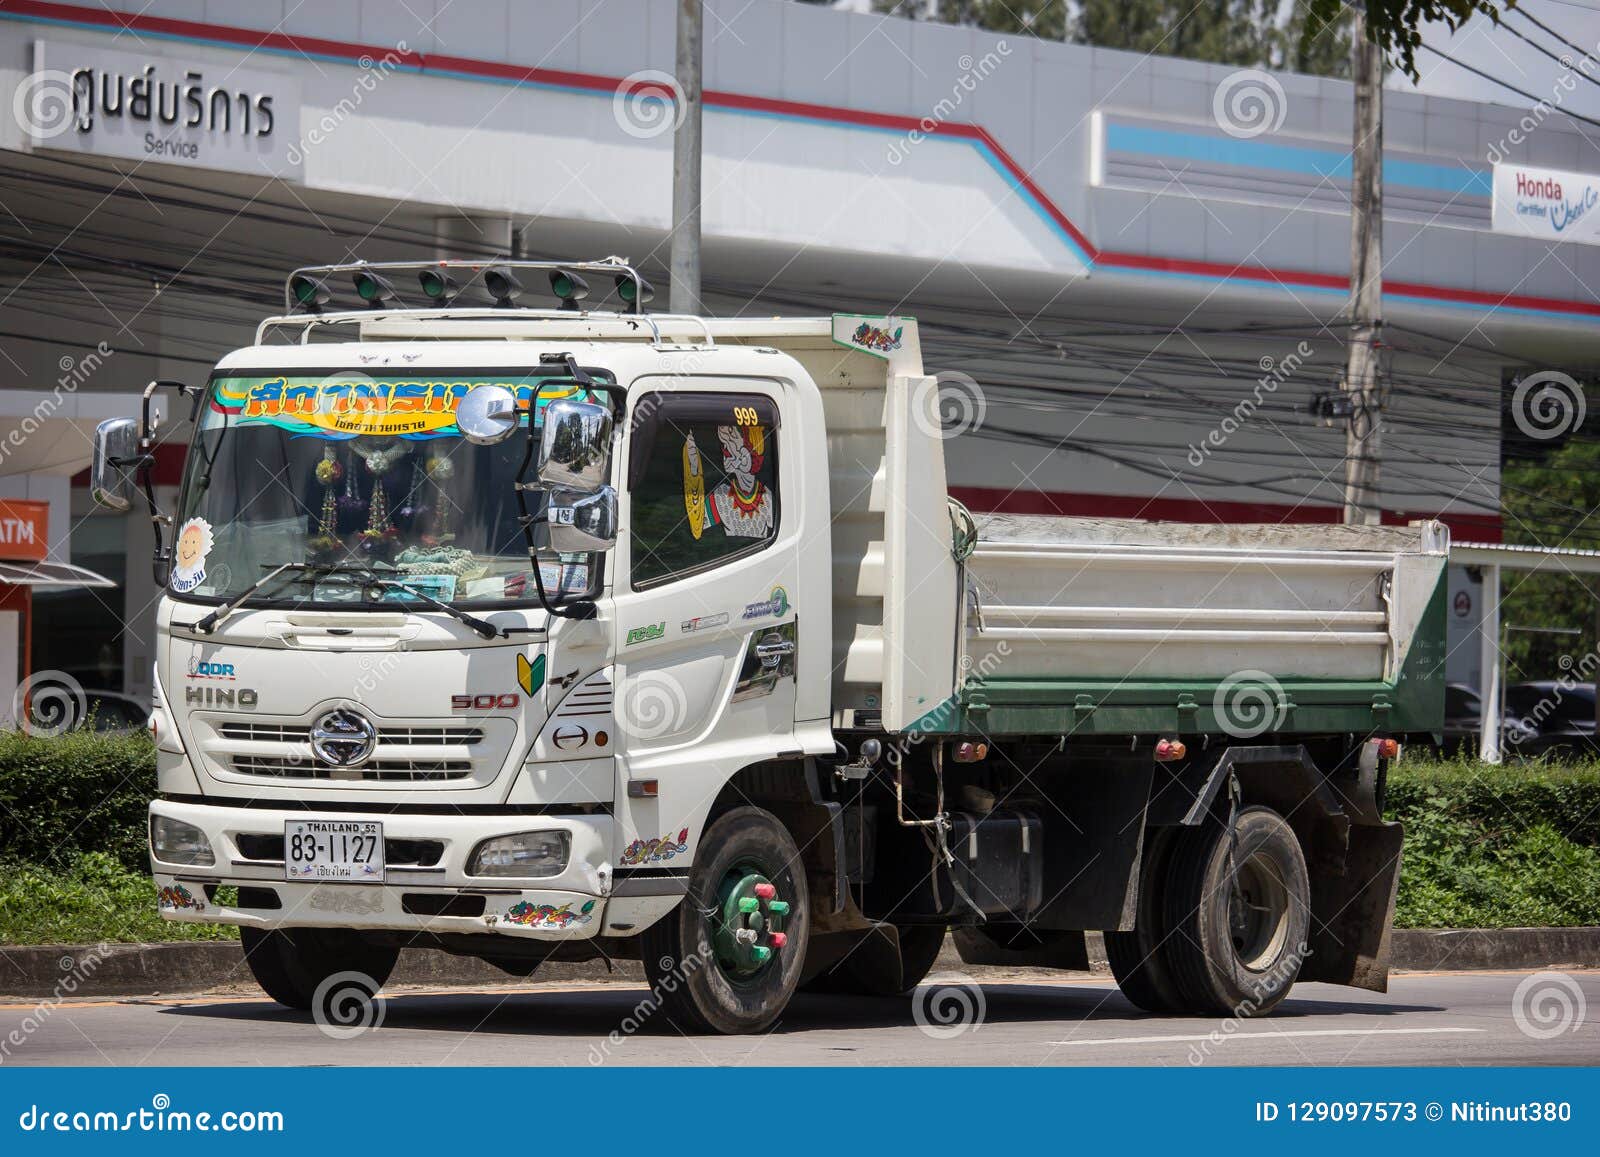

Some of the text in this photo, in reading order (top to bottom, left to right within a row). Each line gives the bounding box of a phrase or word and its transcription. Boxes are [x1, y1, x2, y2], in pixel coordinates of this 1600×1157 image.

[72, 63, 274, 136] ศูนย์บริการ
[143, 132, 199, 159] Service
[1516, 172, 1563, 201] Honda
[733, 406, 758, 426] 999
[198, 662, 235, 676] QDR
[186, 686, 258, 705] HINO
[451, 694, 520, 709] 500
[307, 823, 376, 833] THAILAND 52
[291, 834, 377, 863] 83-1127
[316, 865, 352, 877] เชียงใหม่
